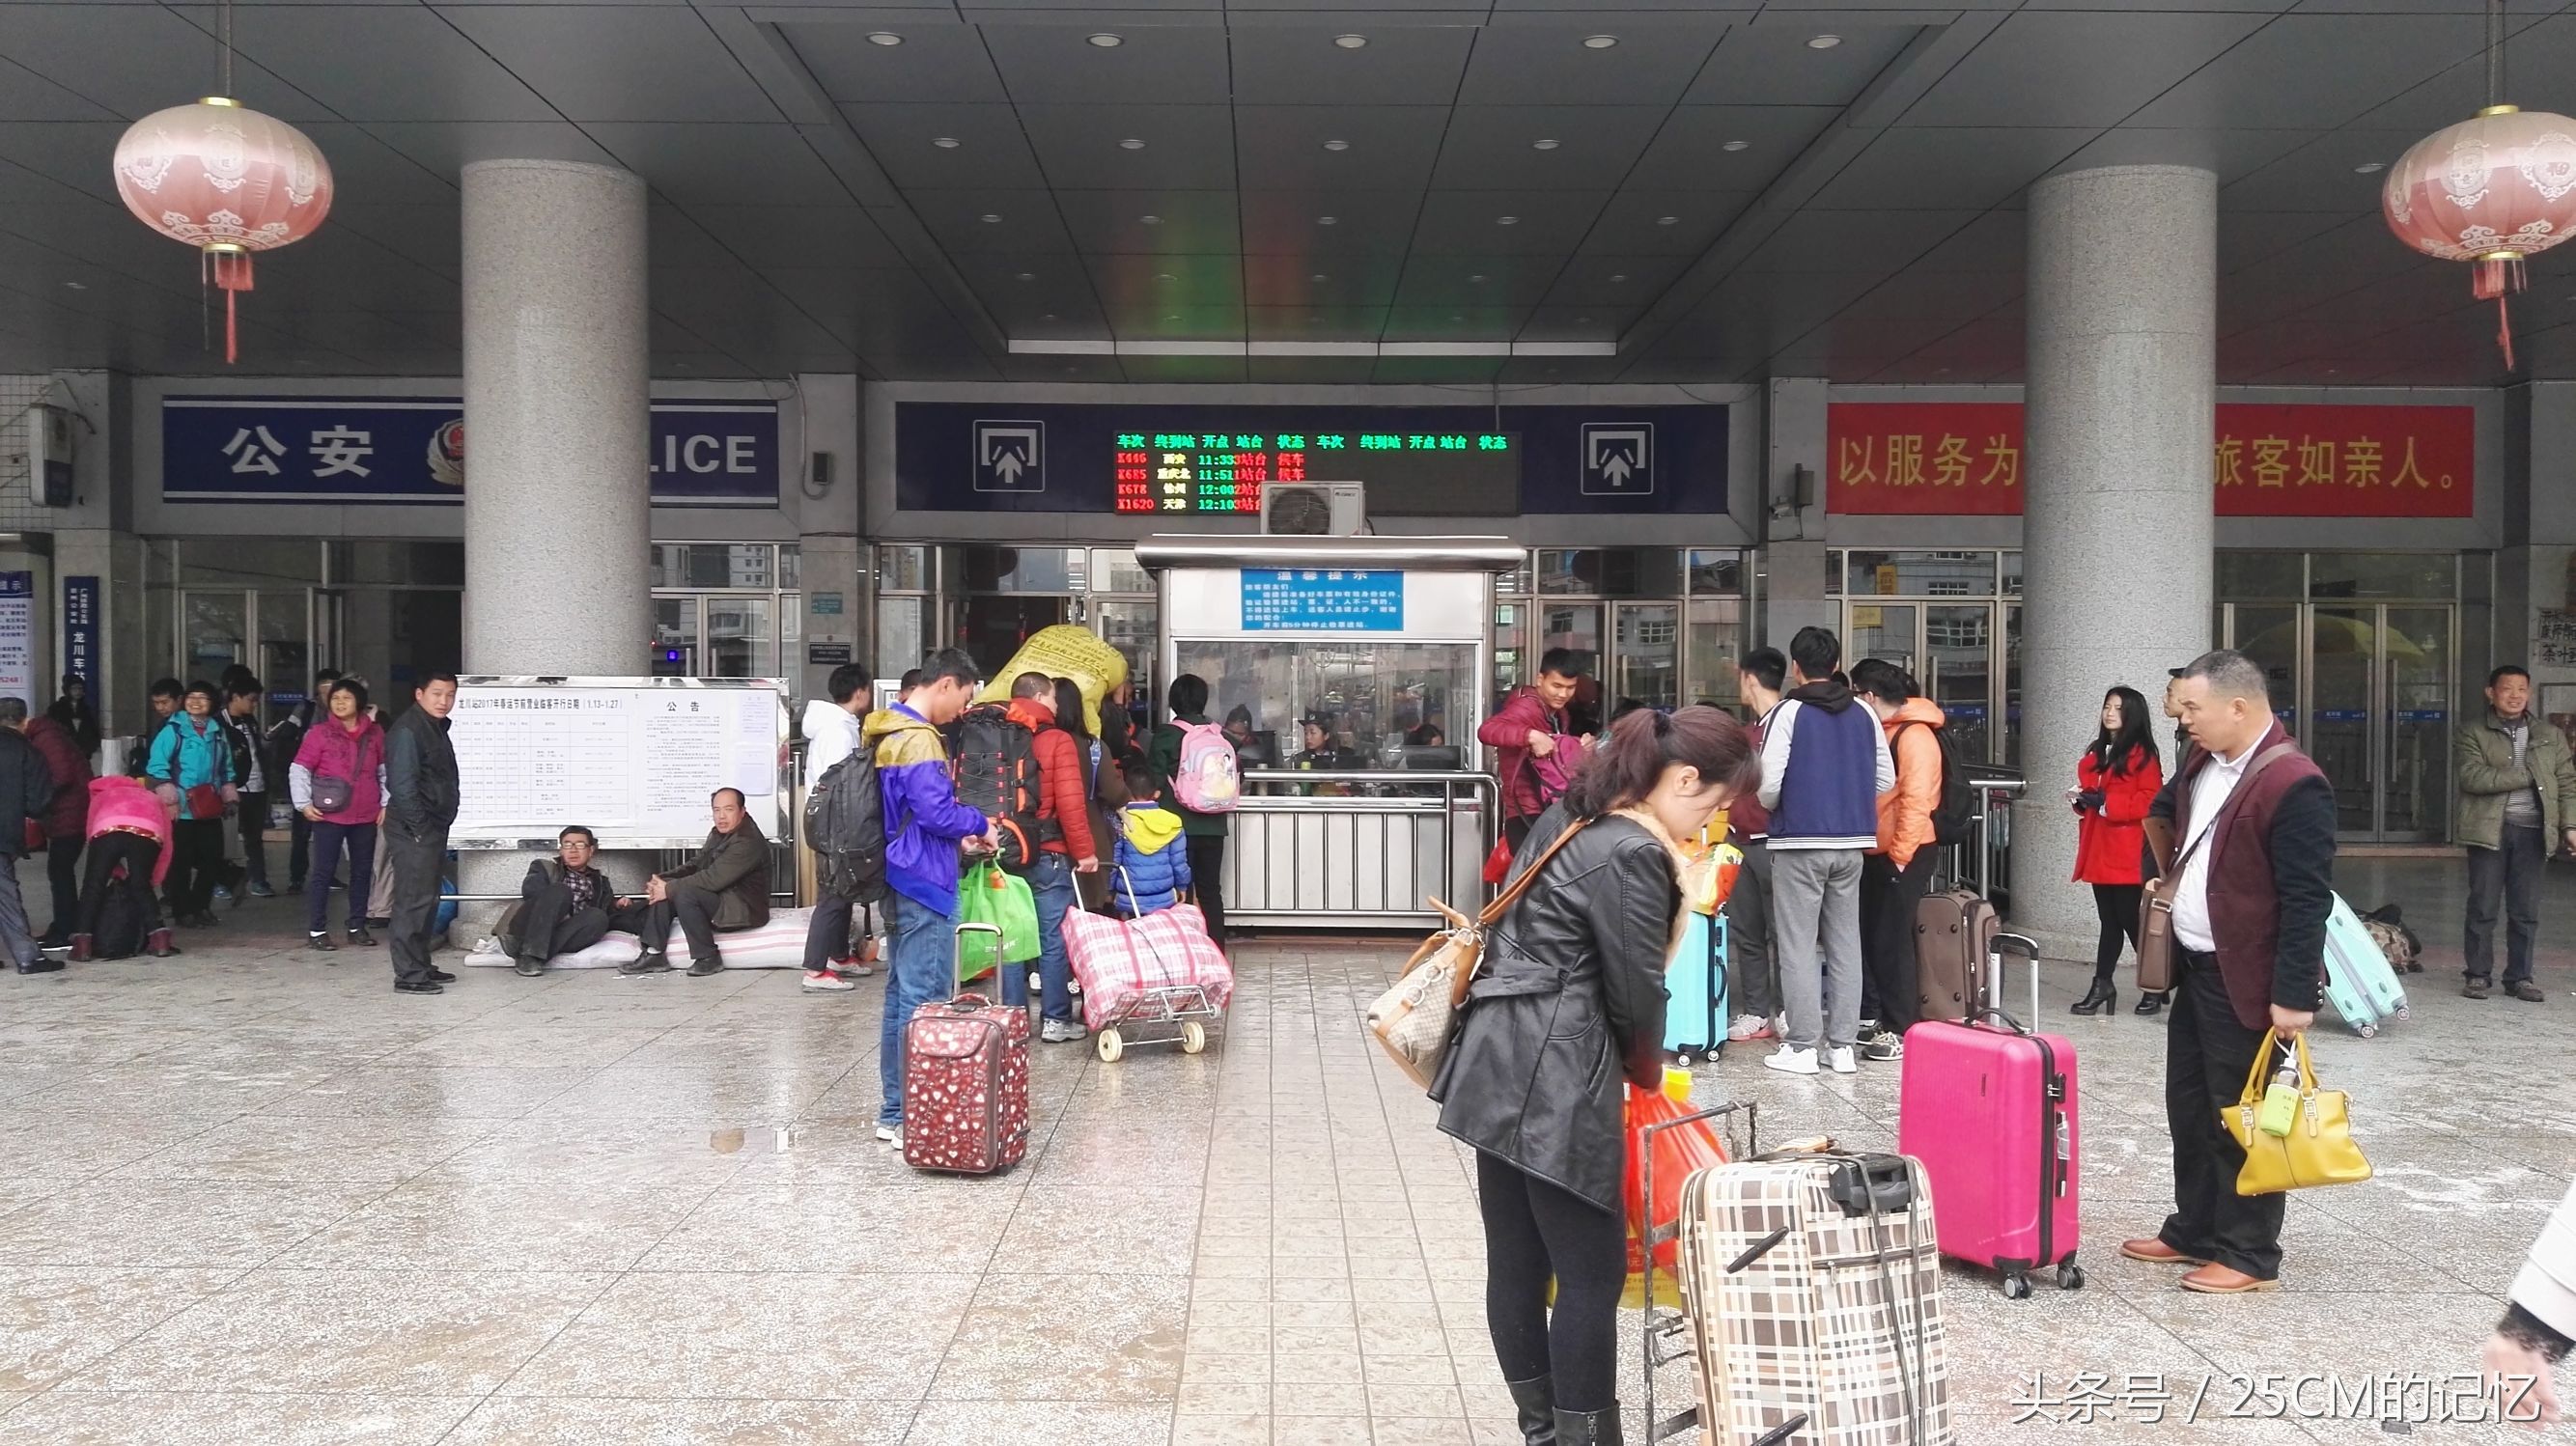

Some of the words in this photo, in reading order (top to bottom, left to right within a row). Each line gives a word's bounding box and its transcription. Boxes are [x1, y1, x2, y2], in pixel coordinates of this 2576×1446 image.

[1117, 434, 1145, 448] 车次
[1154, 434, 1196, 448] 终到站
[1201, 434, 1229, 448] 开点
[1236, 434, 1263, 448] 站台
[1277, 434, 1305, 449] 状态
[1317, 434, 1344, 449] 车次
[1359, 434, 1401, 449] 终到站
[1409, 434, 1436, 449] 开点
[1440, 434, 1467, 449] 站台
[1479, 434, 1507, 450] 状态
[221, 425, 374, 478] 公安
[649, 434, 758, 473] ICE
[1162, 453, 1187, 464] 西安
[1277, 453, 1305, 467] 候车
[1839, 433, 2019, 486] 以服务为
[2214, 434, 2452, 489] 旅客如亲人。
[1157, 468, 1191, 480] 重庆北
[1277, 467, 1305, 481] 候车
[1162, 499, 1187, 510] 天津
[666, 701, 700, 712] 公告
